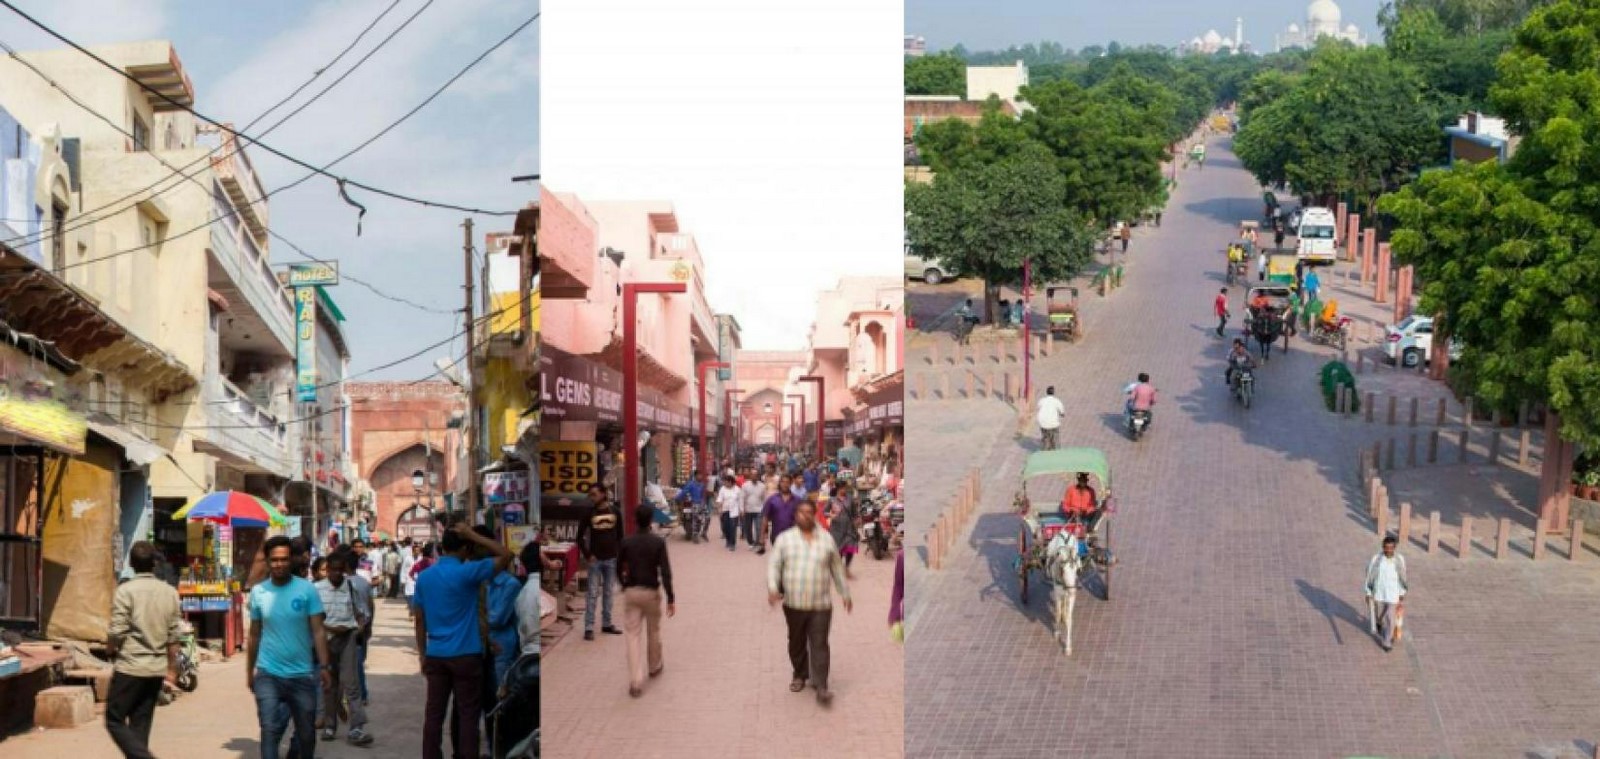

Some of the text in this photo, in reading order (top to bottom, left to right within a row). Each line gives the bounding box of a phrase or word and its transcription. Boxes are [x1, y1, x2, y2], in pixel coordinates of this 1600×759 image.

[556, 376, 591, 406] GEMS
[541, 450, 593, 463] STD
[549, 465, 593, 479] ISD
[541, 480, 592, 493] PCO
